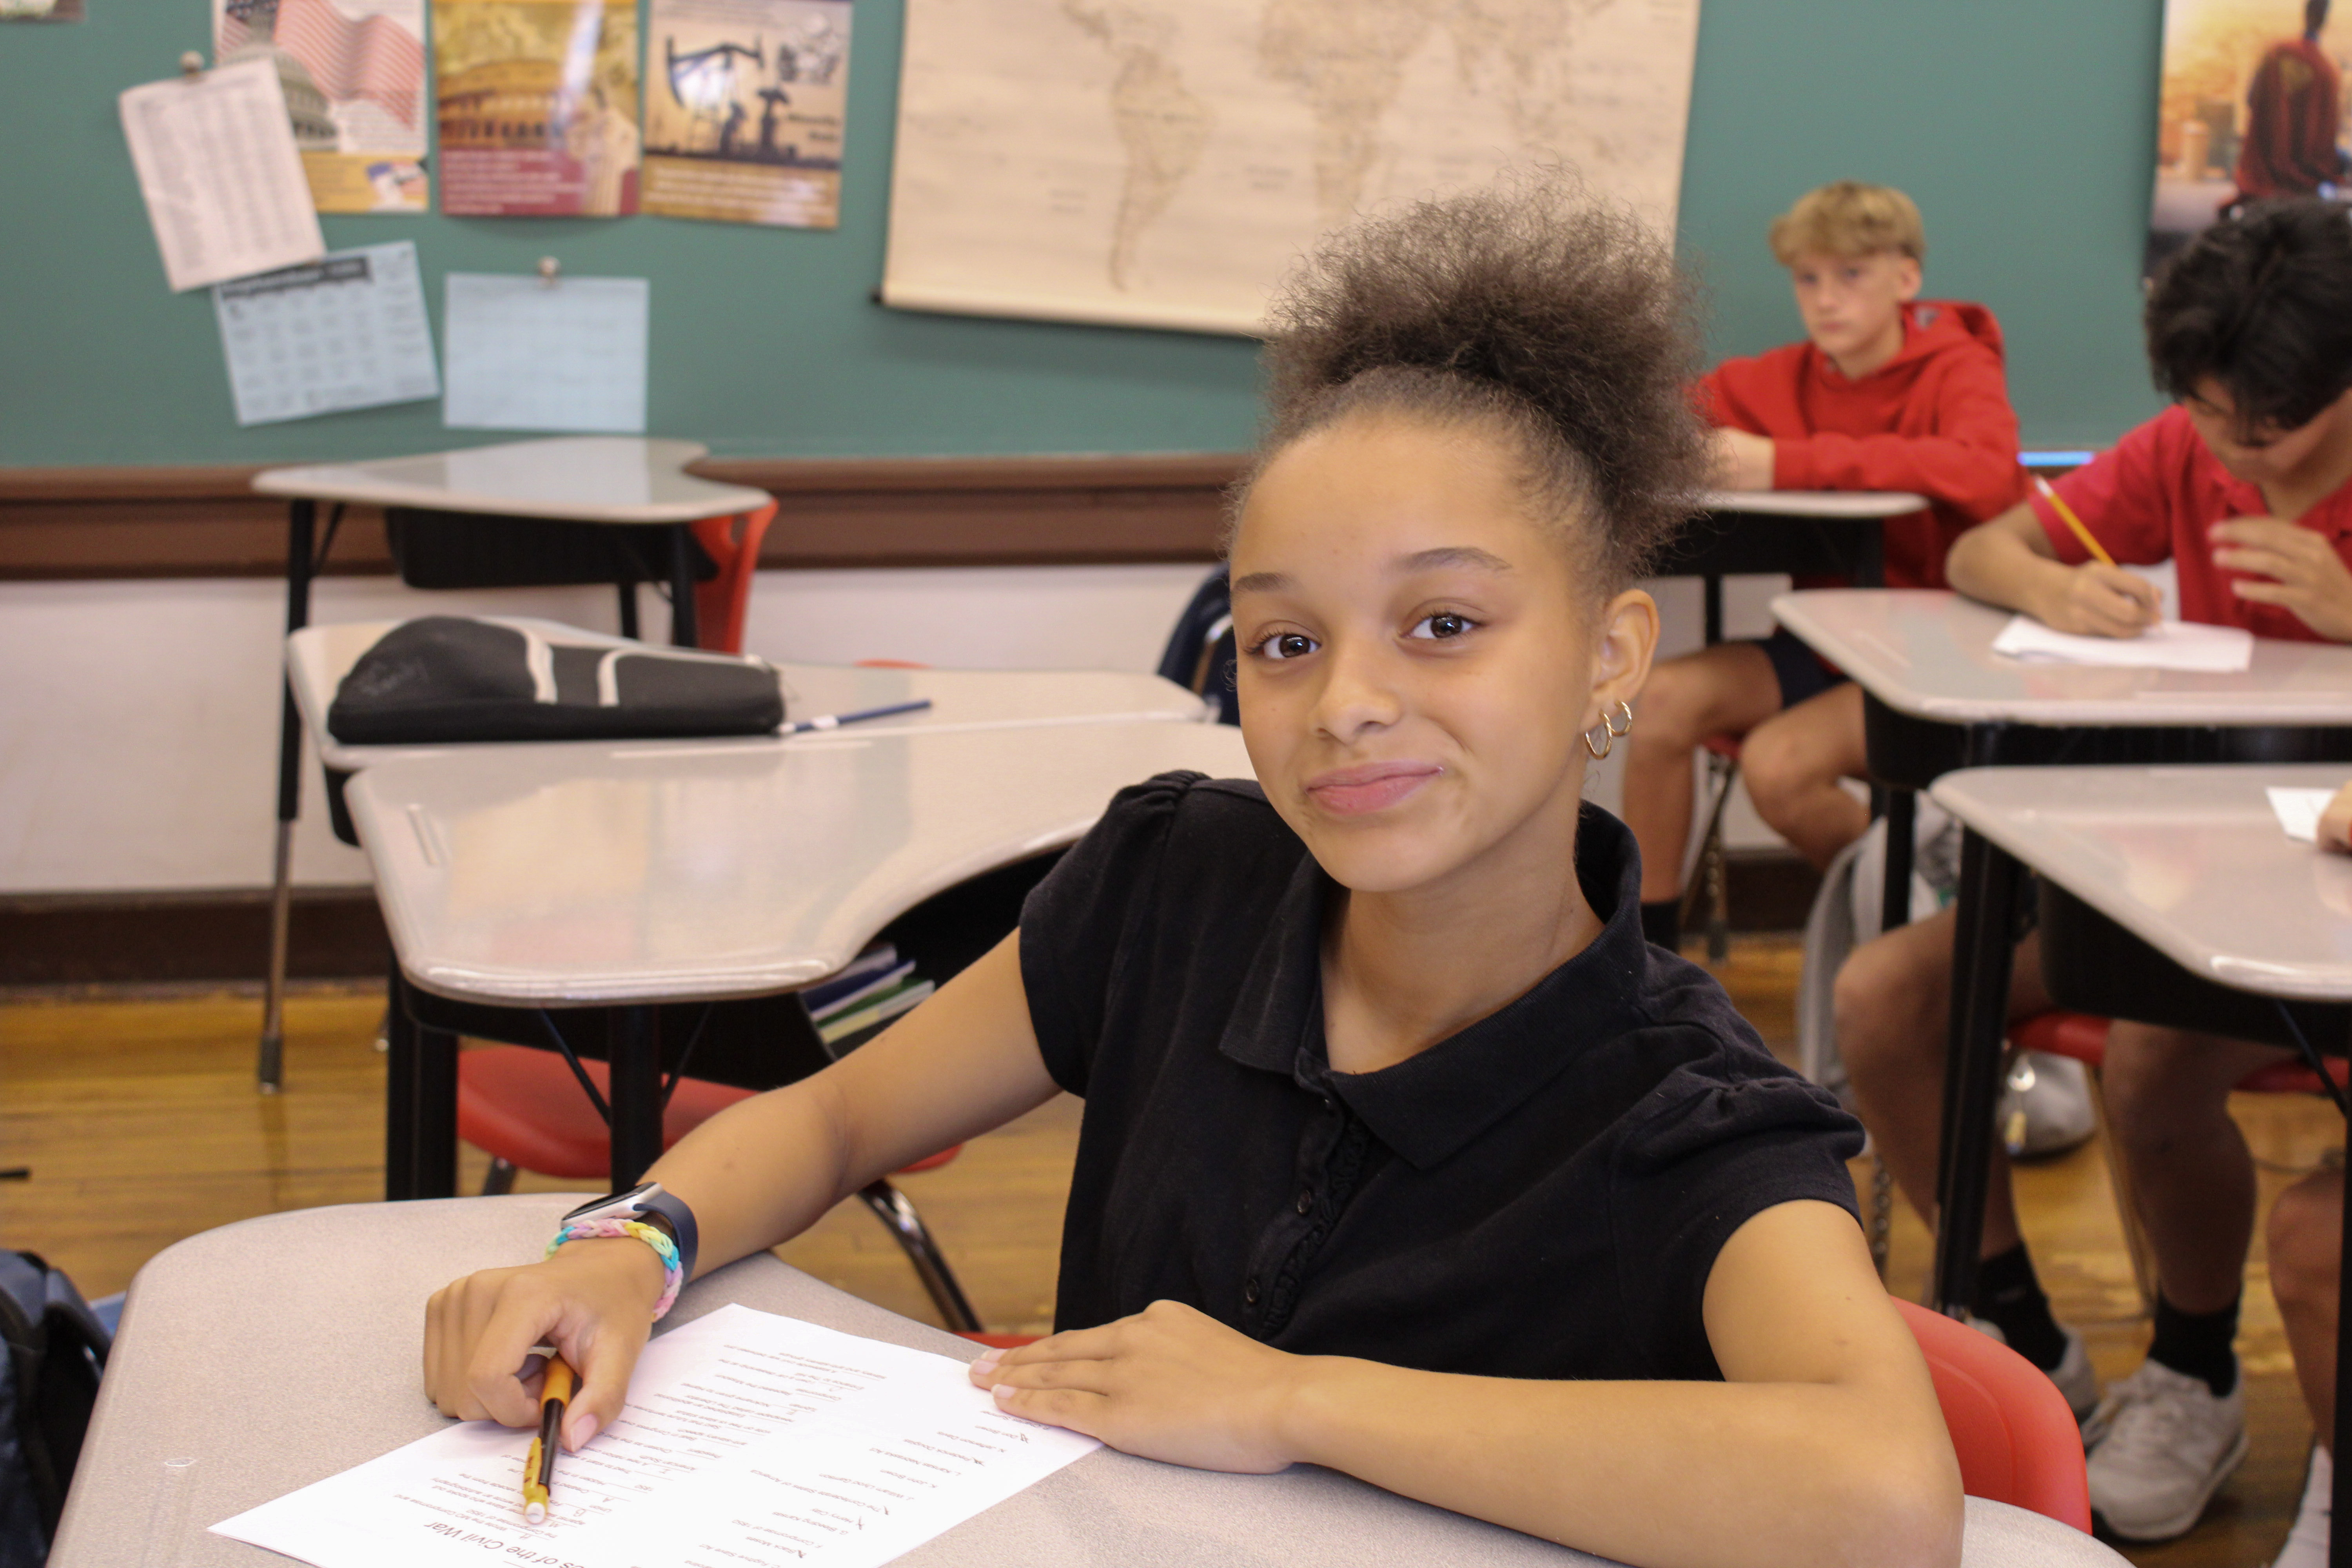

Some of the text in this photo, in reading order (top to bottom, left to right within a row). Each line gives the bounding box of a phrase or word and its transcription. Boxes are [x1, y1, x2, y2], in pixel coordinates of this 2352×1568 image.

[750, 1470, 782, 1482] America
[880, 1469, 906, 1479] Brown
[430, 1478, 483, 1494] autobiography
[489, 1483, 517, 1492] secede
[558, 1483, 590, 1494] Created
[489, 1495, 514, 1504] wrote
[410, 1499, 456, 1515] Compromise
[557, 1516, 586, 1525] against
[772, 1512, 801, 1521] Kansas
[829, 1514, 854, 1523] Henry
[424, 1522, 463, 1537] War
[484, 1522, 508, 1531] Wrote
[496, 1518, 544, 1534] Compromise
[802, 1519, 837, 1532] Bleeding
[460, 1533, 504, 1549] Civil
[745, 1537, 772, 1546] Moses
[763, 1528, 814, 1545] Compromise
[506, 1546, 537, 1559] the
[715, 1548, 737, 1557] Slave
[773, 1545, 797, 1553] Black
[531, 1555, 558, 1565] of
[738, 1555, 769, 1566] Fugitive
